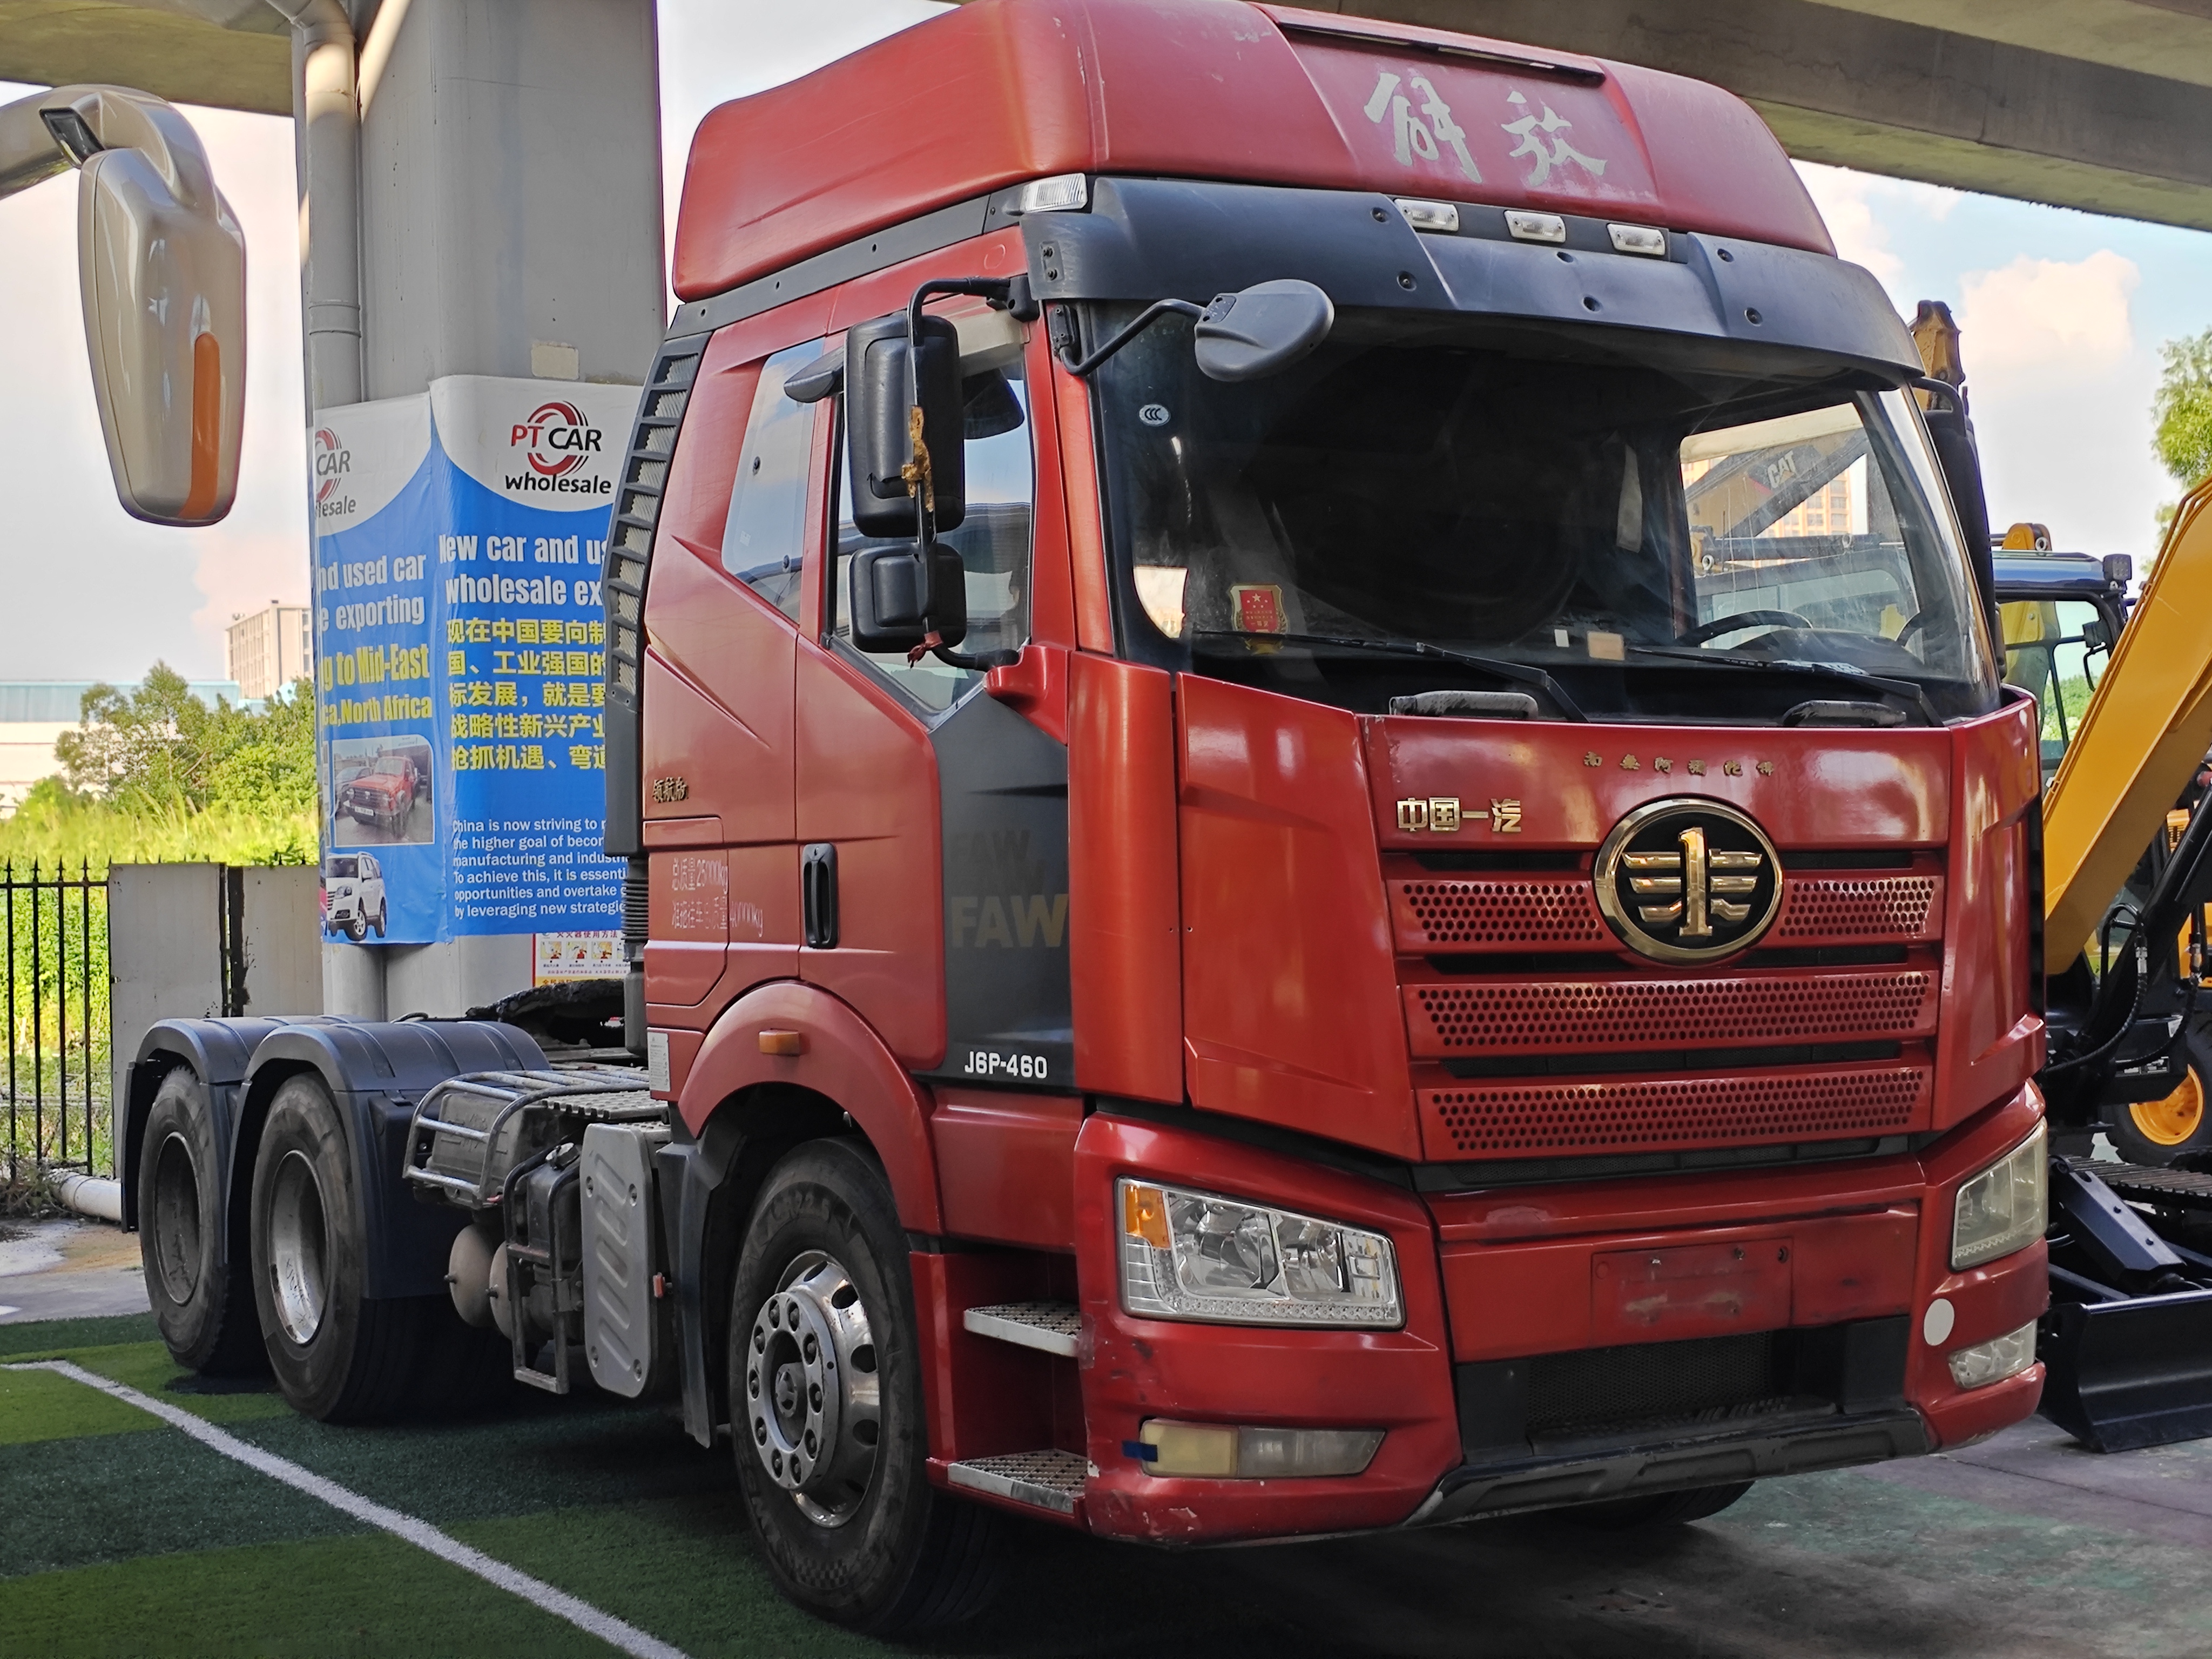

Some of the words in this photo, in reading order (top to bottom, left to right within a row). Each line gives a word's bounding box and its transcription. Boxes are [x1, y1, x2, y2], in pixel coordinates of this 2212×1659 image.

[1364, 72, 1608, 186] 解放
[510, 424, 542, 448] PT
[548, 427, 603, 452] CAR
[316, 450, 351, 476] CAR
[1767, 450, 1796, 488] CAT
[505, 471, 612, 495] wholesale
[439, 534, 478, 564] New
[487, 535, 527, 562] car
[534, 535, 579, 564] and
[320, 562, 340, 591] nd
[342, 555, 388, 589] used
[393, 554, 427, 583] car
[446, 573, 567, 605] wholesale
[574, 579, 604, 606] ex
[321, 607, 329, 632] e
[335, 594, 426, 632] exporting
[336, 651, 355, 686] to
[356, 643, 430, 684] Mid-East
[320, 697, 382, 727] ca,North
[383, 693, 433, 721] Africa
[453, 819, 484, 832] China
[488, 819, 500, 832] is
[503, 820, 531, 832] now
[534, 818, 582, 833] striving
[584, 818, 598, 830] to
[1397, 797, 1522, 833] 中国一汽
[453, 838, 468, 850] the
[471, 836, 515, 852] higher
[518, 835, 547, 851] goal
[550, 835, 564, 847] of
[453, 853, 545, 868] manufacturing
[549, 852, 573, 864] and
[454, 871, 464, 884] To
[467, 870, 519, 883] achieve
[522, 868, 550, 884] this,
[554, 868, 563, 881] it
[566, 868, 577, 881] is
[580, 867, 626, 880] essenti
[454, 885, 534, 903] opportunities
[536, 885, 560, 898] and
[563, 884, 617, 897] overtake
[454, 905, 464, 920] by
[467, 902, 538, 918] leveraging
[541, 902, 567, 915] new
[951, 893, 1069, 948] FAW
[964, 1050, 1049, 1079] J6P-460
